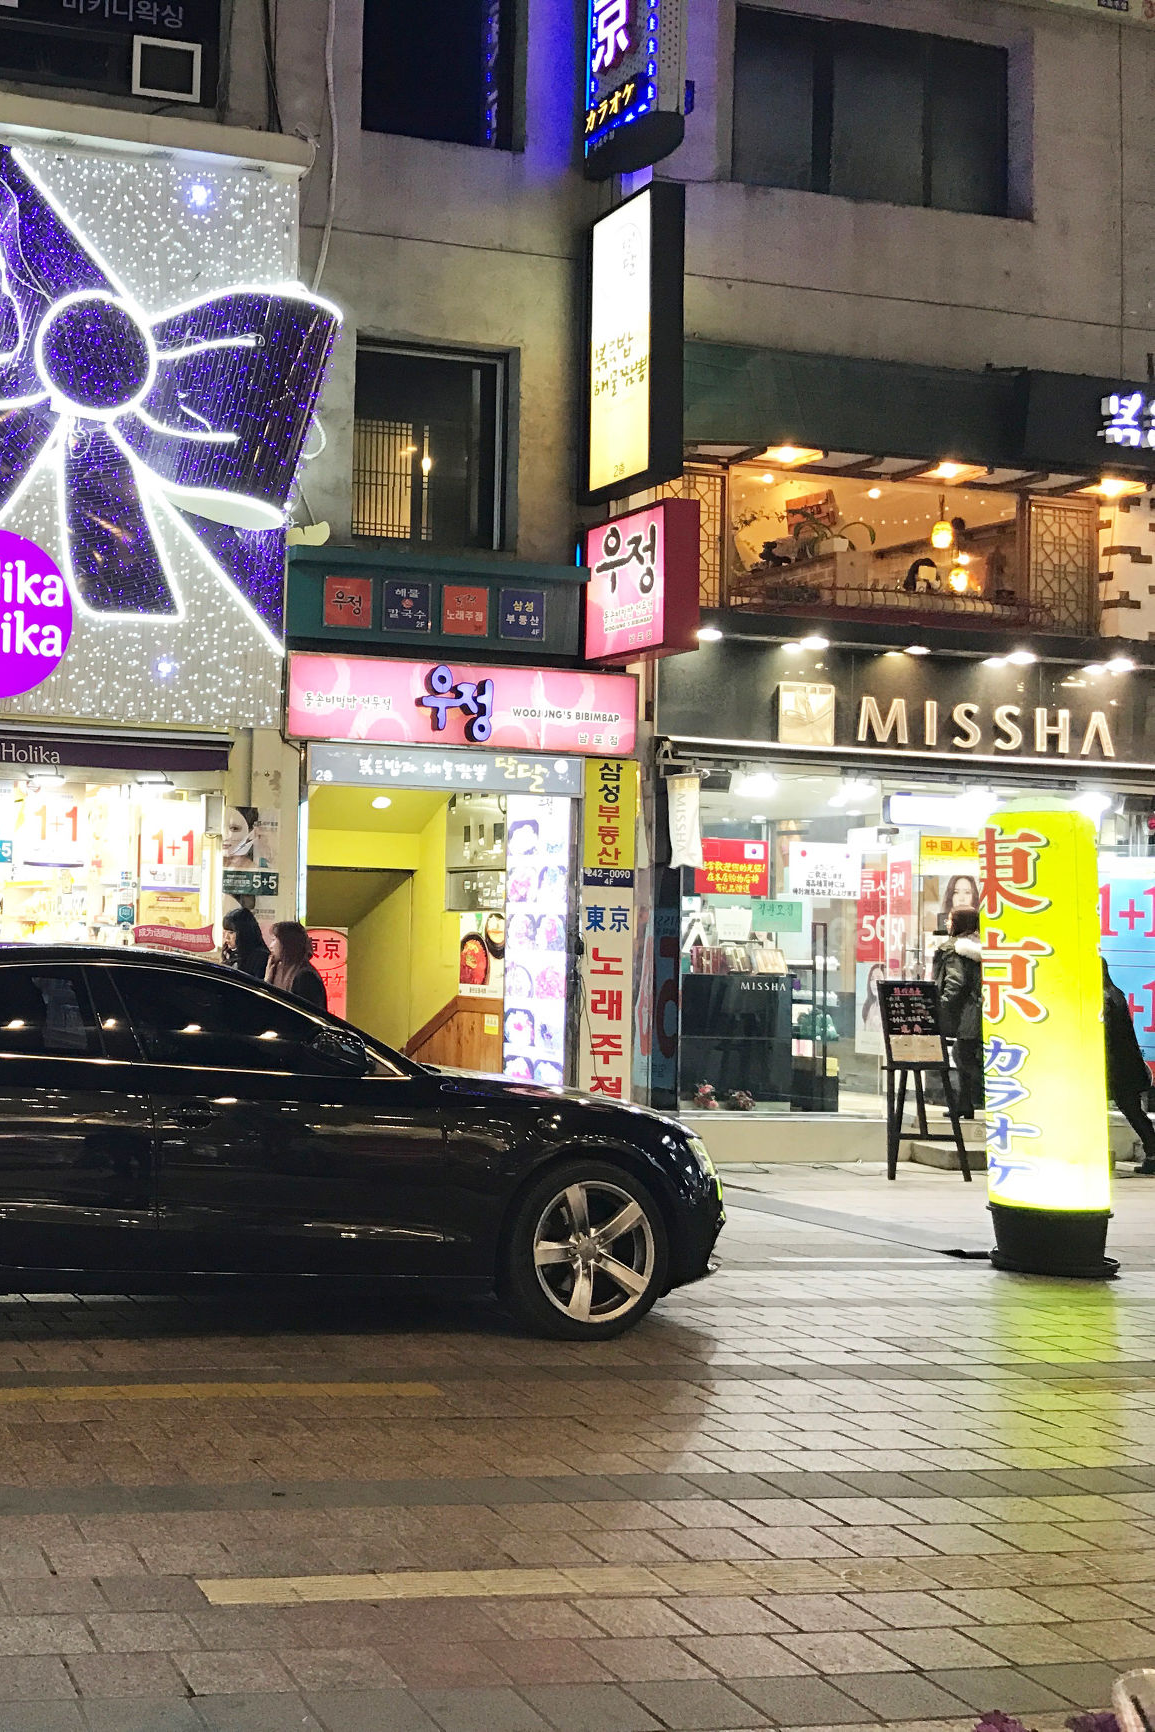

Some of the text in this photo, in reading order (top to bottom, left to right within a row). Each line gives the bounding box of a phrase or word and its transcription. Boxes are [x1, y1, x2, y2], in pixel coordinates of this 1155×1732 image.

[585, 82, 635, 134] カラオケ
[1099, 392, 1155, 448] 볶
[596, 523, 657, 595] 우정
[332, 590, 363, 616] 우정
[512, 600, 535, 613] 삼성
[387, 608, 427, 620] 칼국수
[446, 609, 484, 622] 노래주점
[506, 613, 540, 626] 부동산
[415, 620, 426, 628] 2F
[530, 629, 541, 637] 4F
[416, 666, 494, 742] 우정
[575, 711, 621, 723] BIBIMBAP
[857, 696, 1116, 758] MISSHA
[579, 733, 619, 747] 남포점
[1, 743, 62, 765] Holika
[495, 756, 551, 793] 달달
[675, 793, 688, 853] MISSHA
[152, 829, 195, 866] 1+1
[252, 874, 278, 890] 5+5
[586, 868, 631, 881] 242-0090
[603, 878, 615, 886] 4F
[585, 905, 631, 933] 東京
[740, 981, 787, 992] MISSHA
[588, 946, 624, 1099] 노래주점
